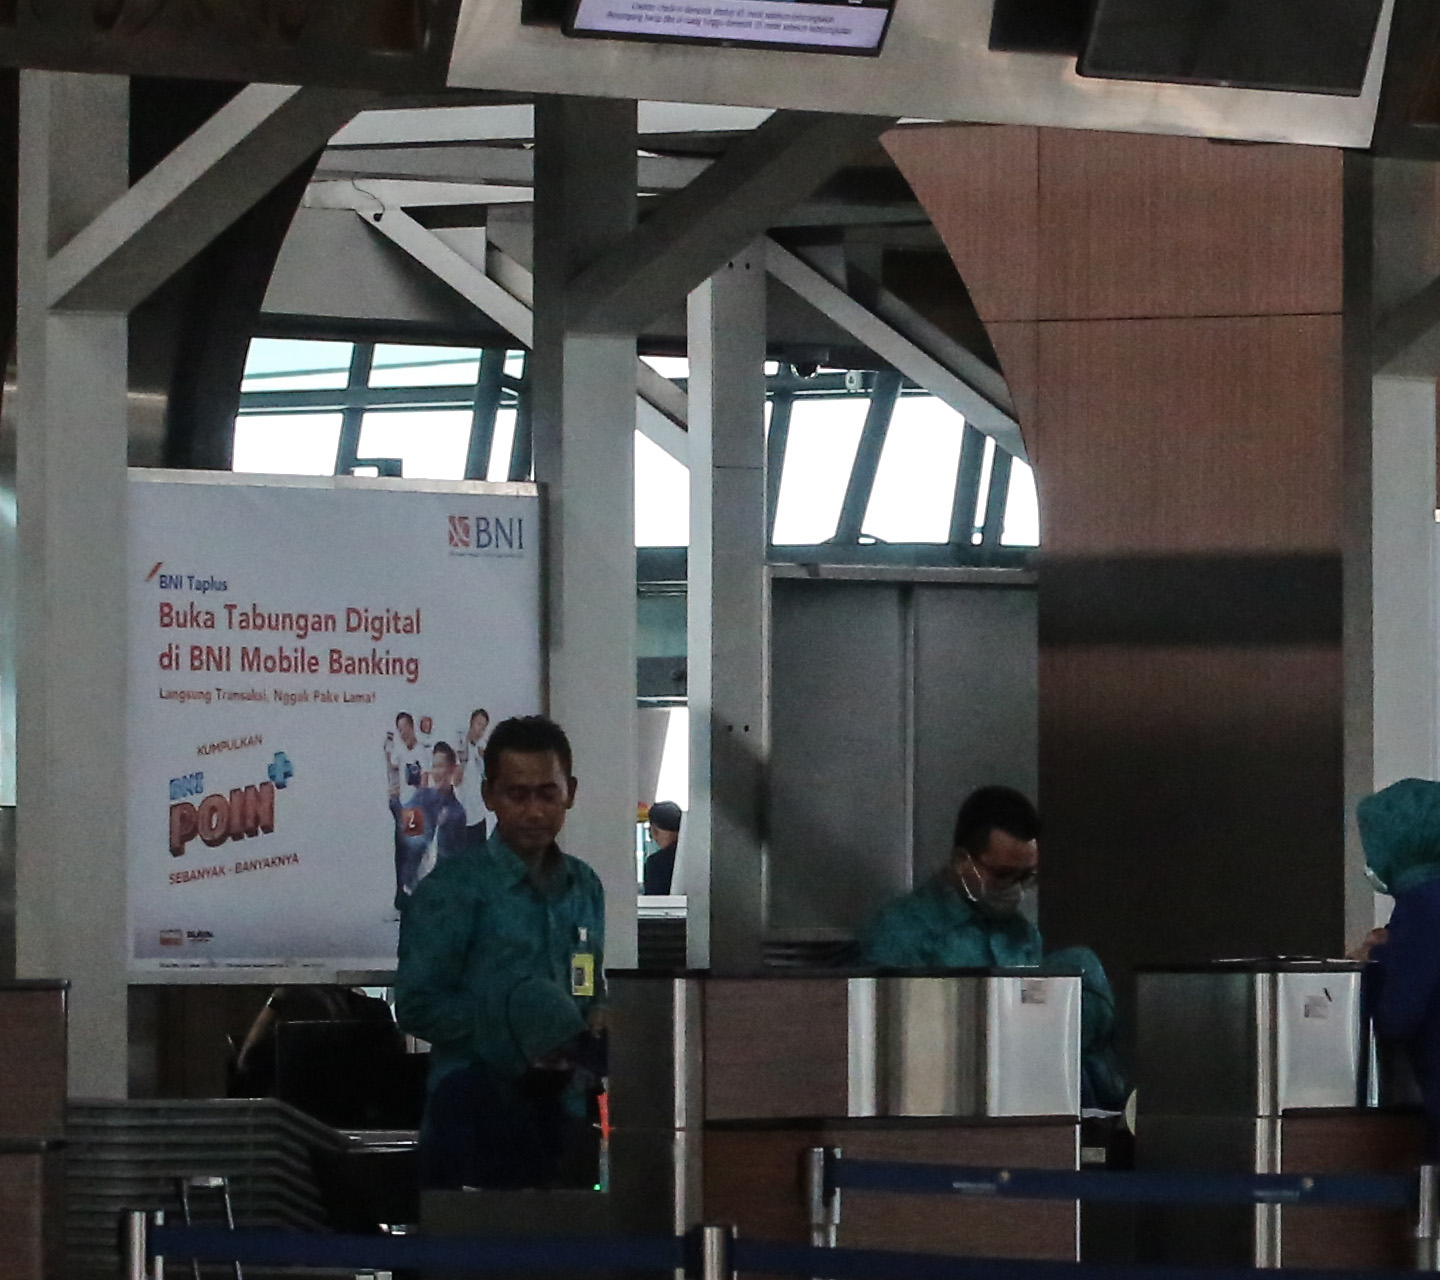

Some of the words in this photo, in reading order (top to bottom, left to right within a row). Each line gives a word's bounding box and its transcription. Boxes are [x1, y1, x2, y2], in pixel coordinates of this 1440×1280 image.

[475, 517, 524, 549] BNI
[160, 575, 183, 589] BNI
[188, 576, 228, 593] Taplus
[160, 602, 215, 629] Buka
[224, 604, 336, 639] Tabungan
[346, 607, 421, 642] Digital
[159, 644, 180, 670] di
[189, 646, 231, 672] BNI
[240, 647, 319, 674] Mobile
[329, 648, 419, 683] Banking
[160, 688, 211, 703] Langsung
[274, 690, 309, 705] Nggak
[314, 691, 340, 703] Pake
[343, 691, 376, 703] Lama!
[197, 734, 263, 756] KUMPULKAN
[170, 772, 204, 800] BNI
[169, 866, 226, 885] SEBANYAK
[235, 852, 299, 874] BANYAKNYA
